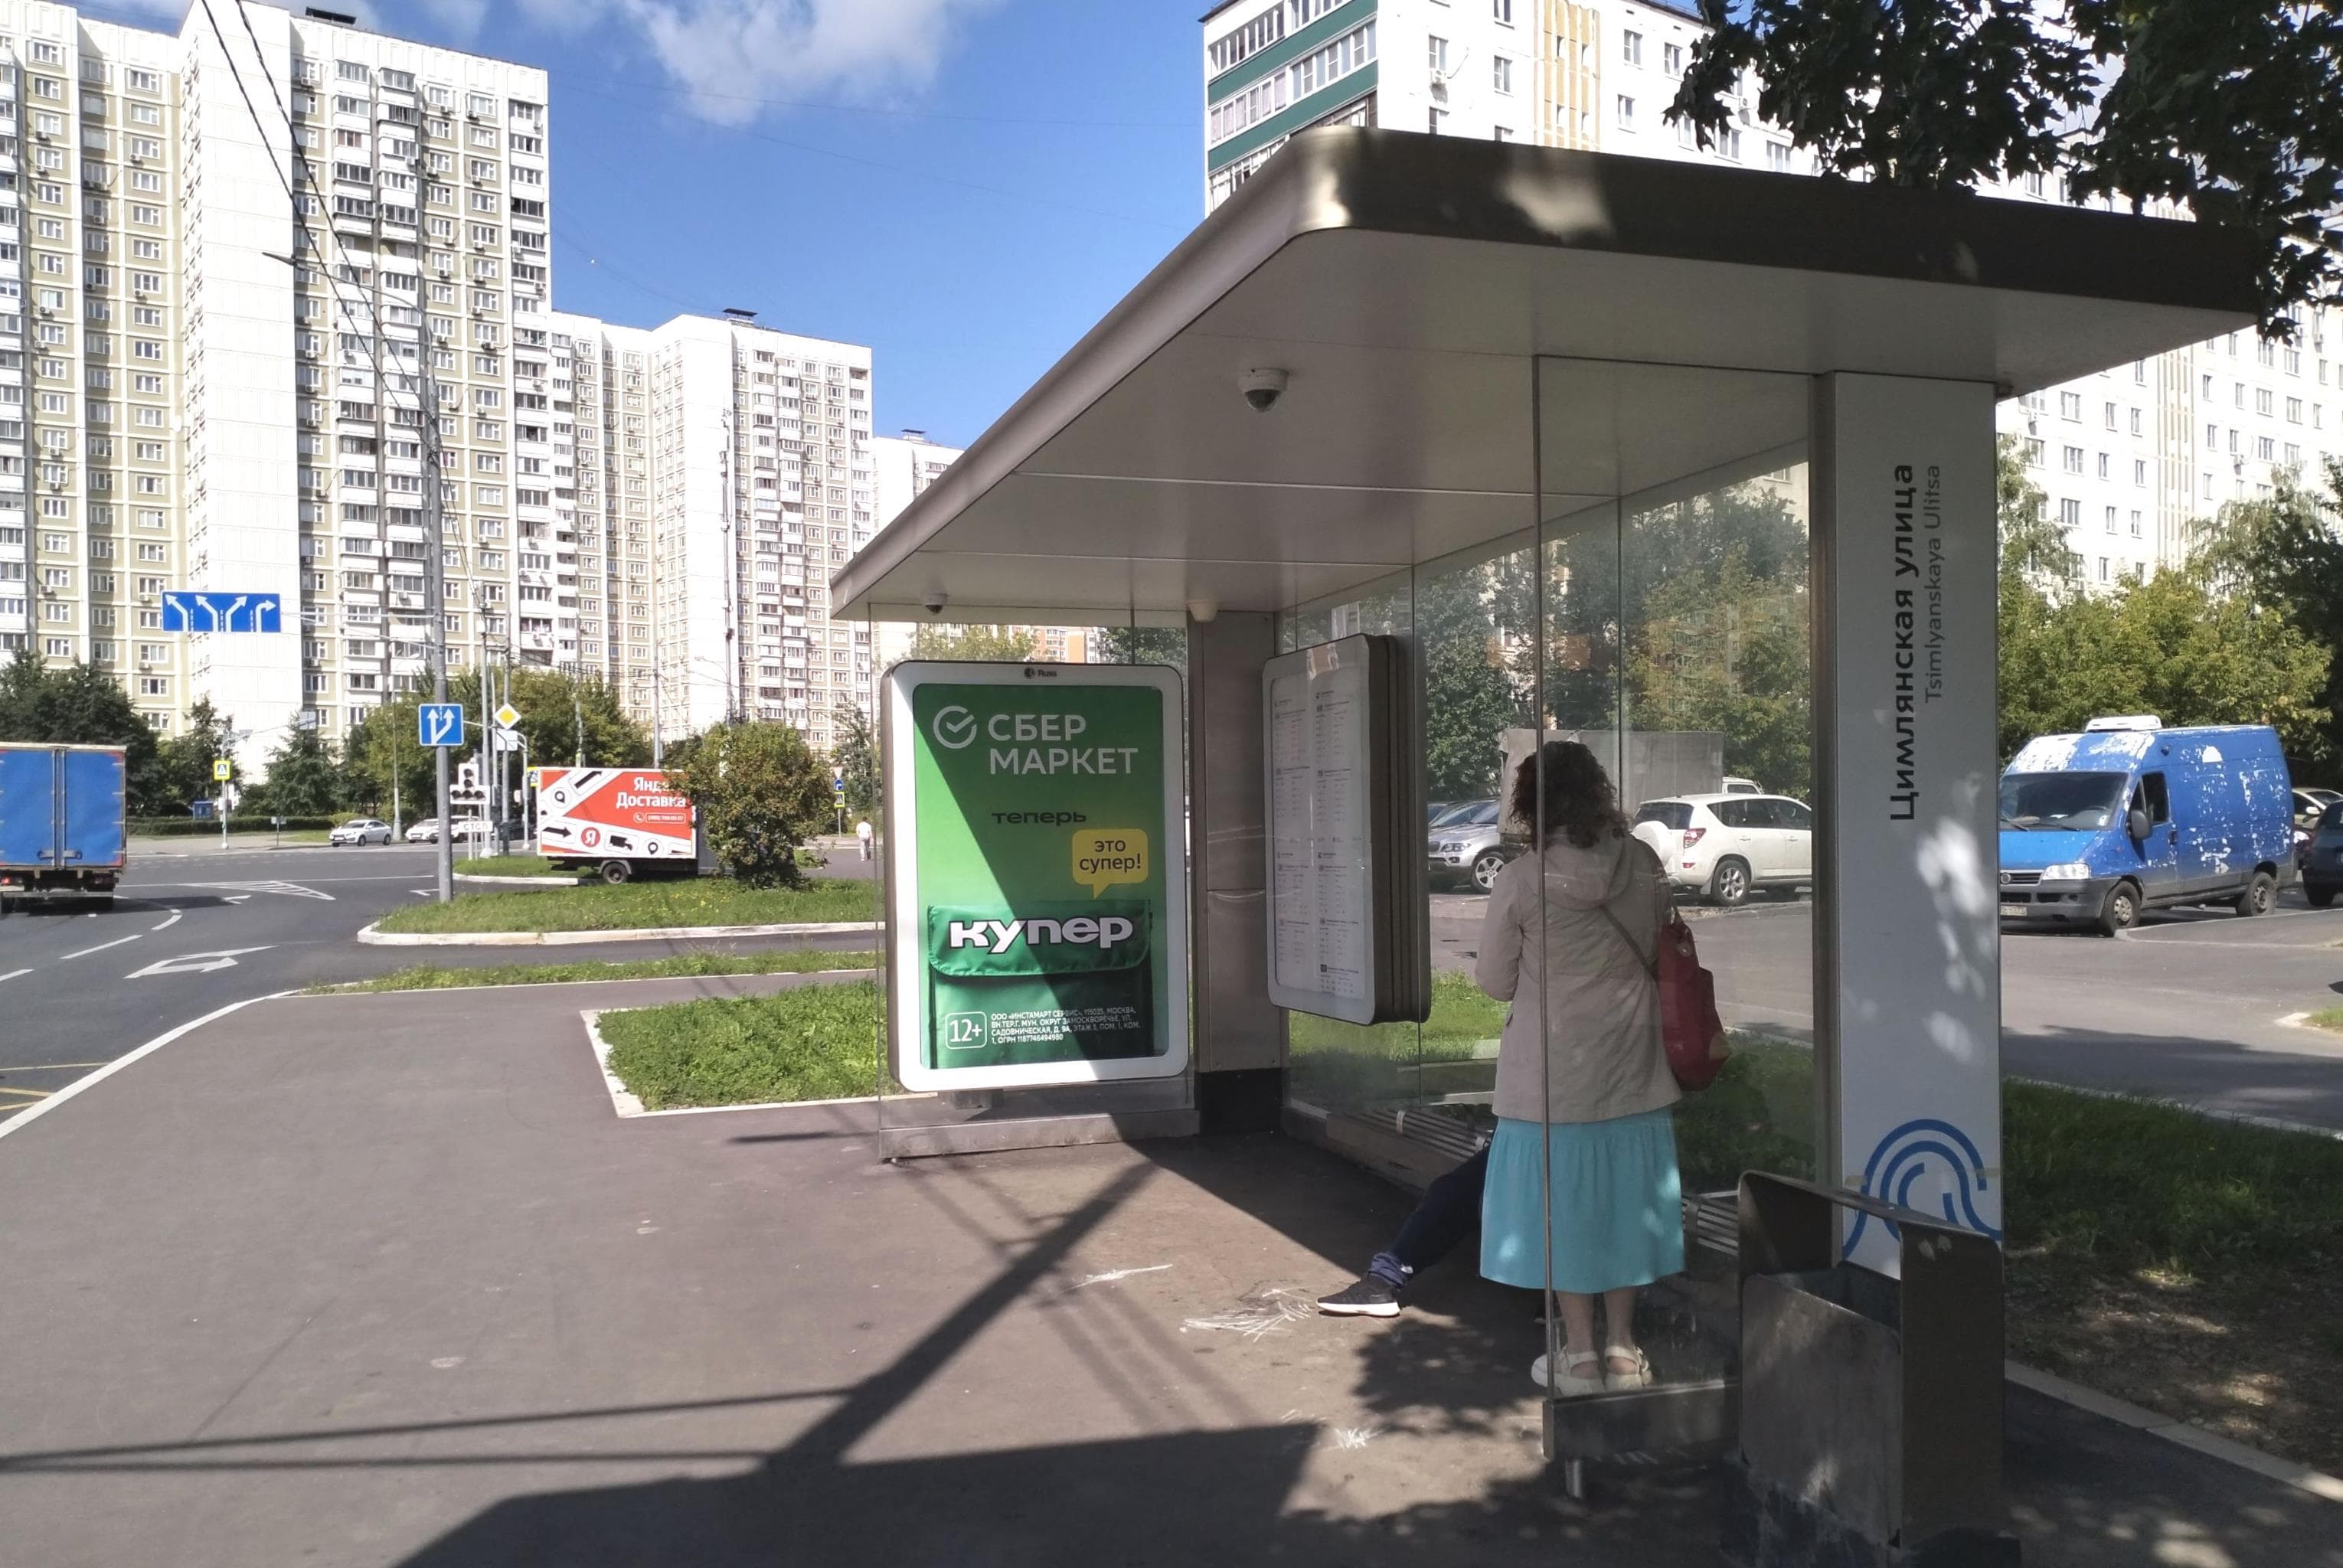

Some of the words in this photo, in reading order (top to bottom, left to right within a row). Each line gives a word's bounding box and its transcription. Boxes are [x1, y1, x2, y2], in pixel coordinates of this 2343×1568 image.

[1924, 464, 1941, 530] Ulitsa
[1894, 464, 1920, 578] улица
[1924, 537, 1946, 704] Tsimlyanskaya
[1890, 589, 1920, 821] Цимлянская
[988, 714, 1087, 742] СБЕР
[990, 746, 1139, 775] МАРКЕТ
[616, 792, 686, 808] Доставка
[992, 811, 1087, 826] теперь
[1093, 839, 1126, 853] это
[1078, 854, 1142, 874] супер!
[948, 915, 1135, 956] купер
[949, 1019, 982, 1042] 12+
[992, 1027, 1052, 1036] САДОВНИЧЕСКАЯ,
[1040, 1018, 1061, 1026] ОКРУГ
